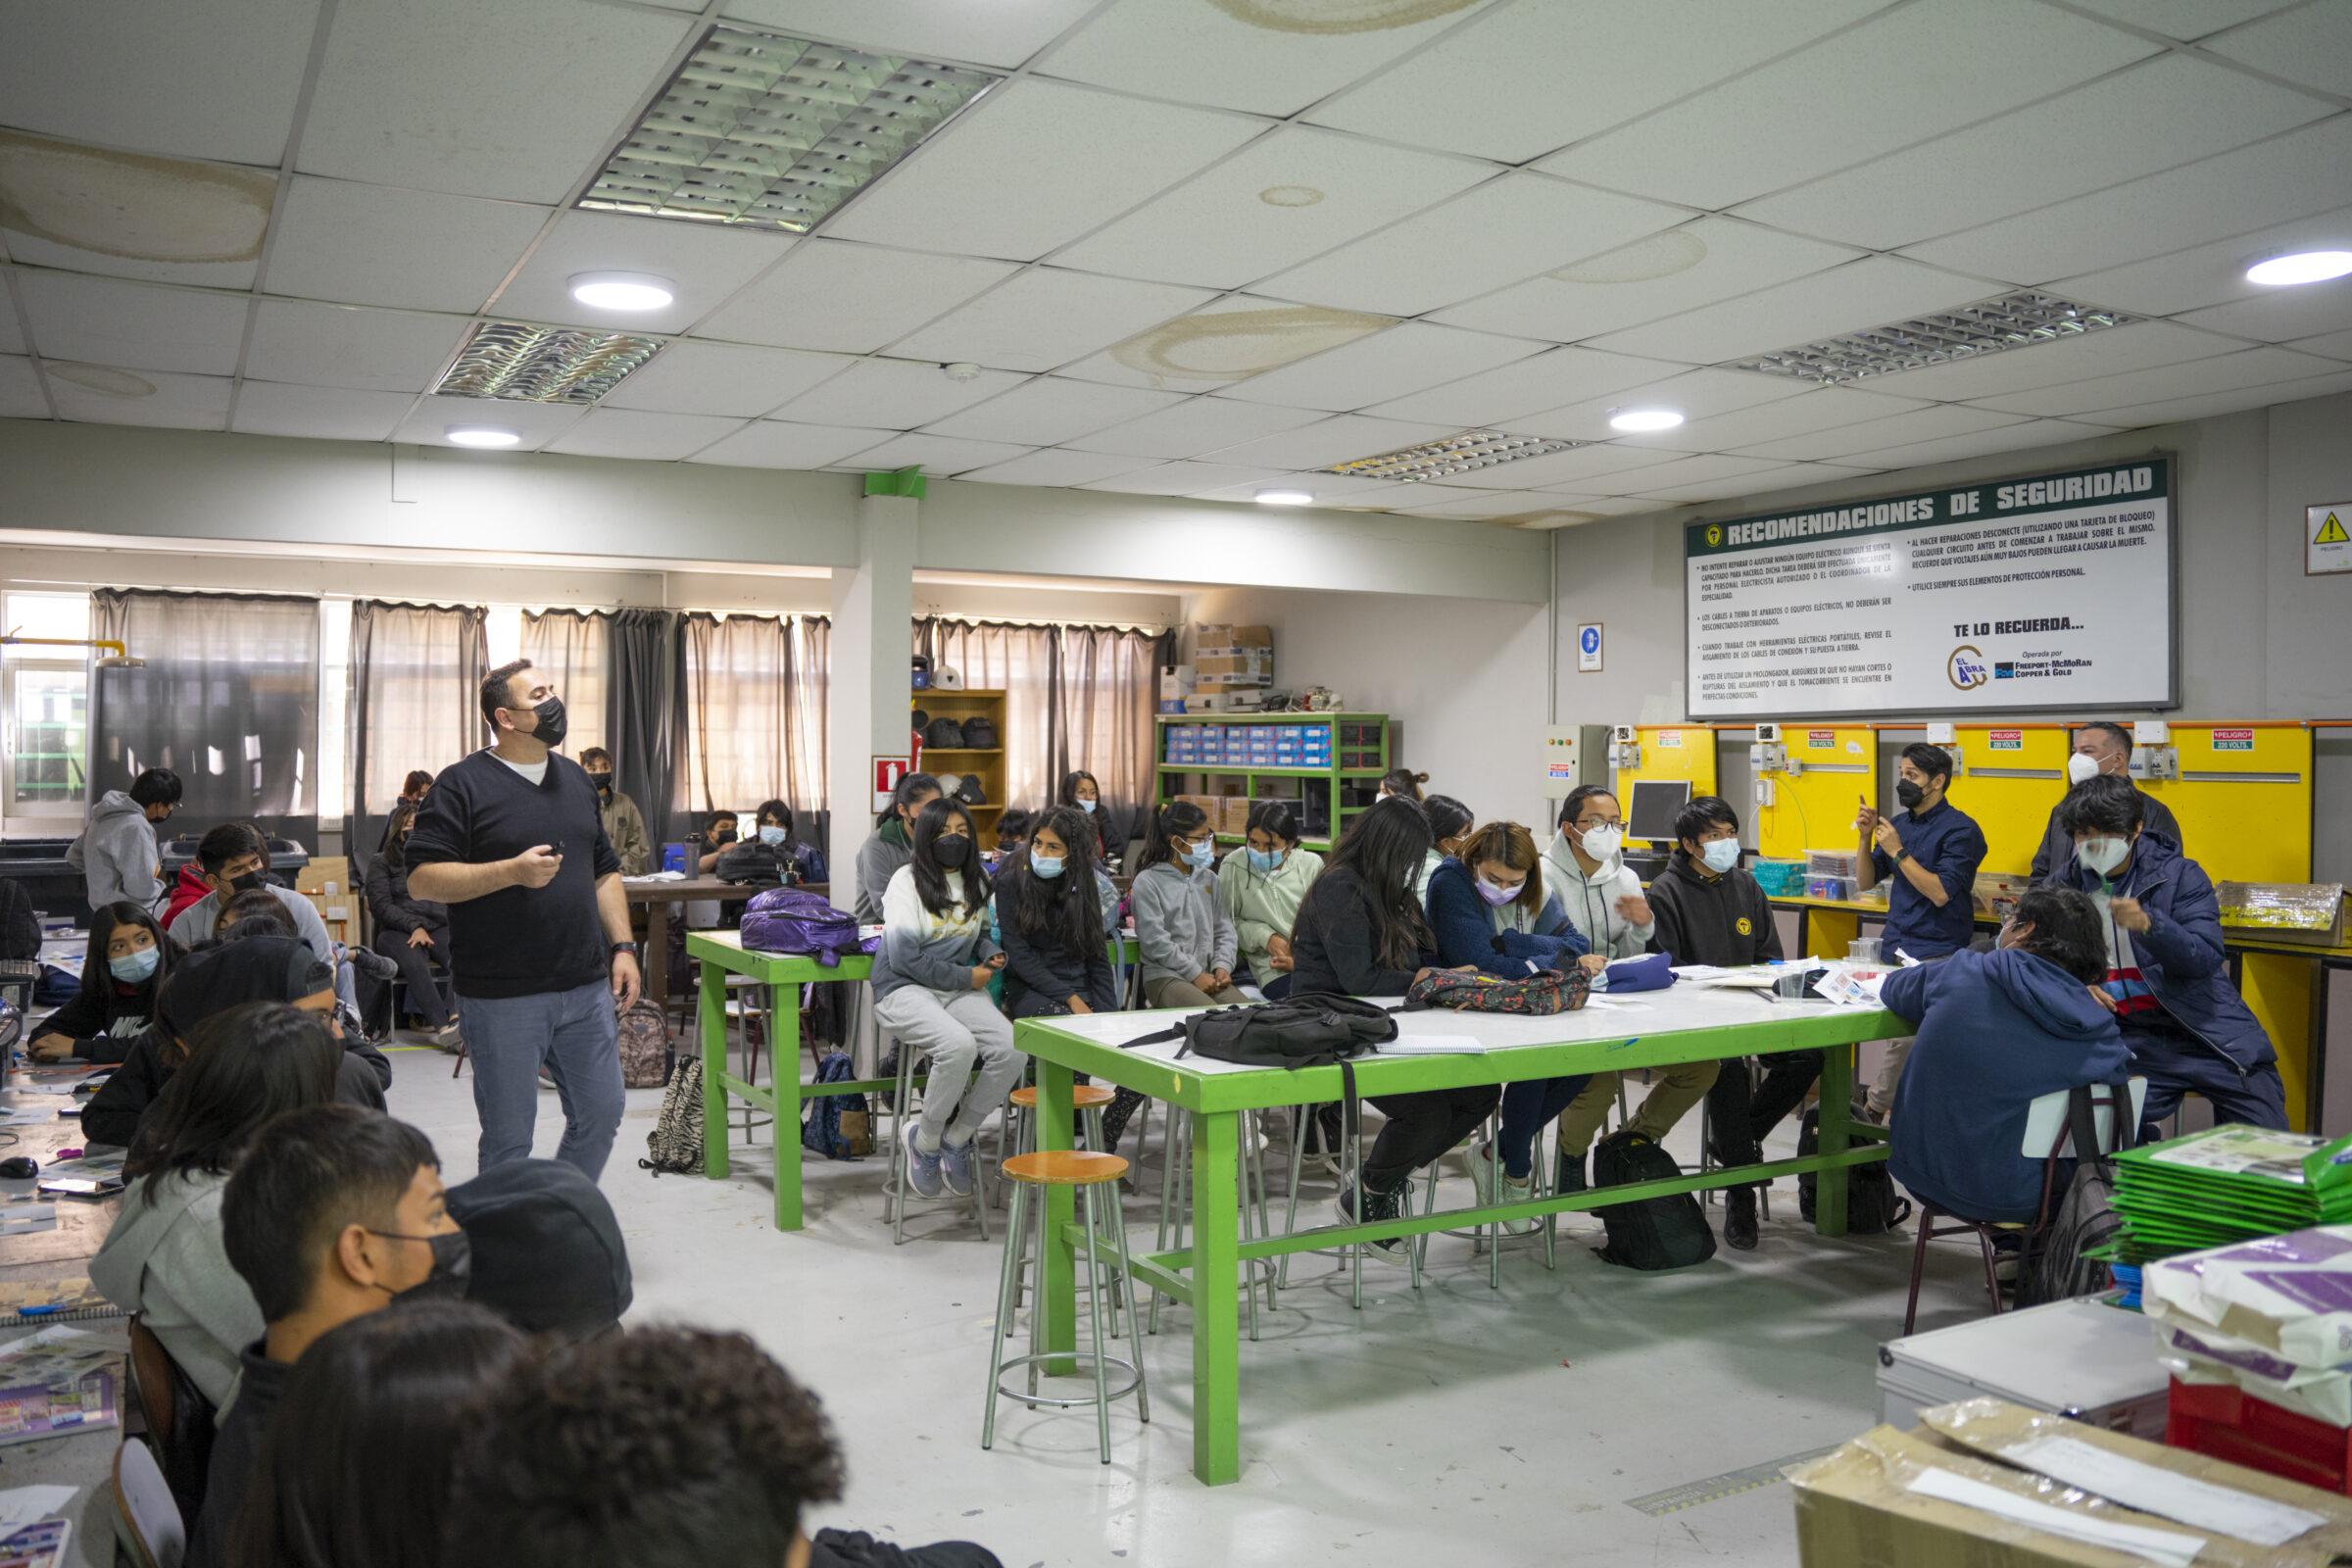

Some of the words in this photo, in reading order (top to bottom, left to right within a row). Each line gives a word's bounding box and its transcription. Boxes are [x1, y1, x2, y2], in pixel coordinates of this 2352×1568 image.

[1728, 498, 1934, 545] RECOMENDACIONES
[1950, 491, 1979, 516] DE
[1997, 467, 2152, 510] SEGURIDAD
[1920, 536, 1938, 545] HACER
[1940, 531, 1981, 543] REPARACIONES
[1983, 527, 2021, 538] DESCONECTE
[2022, 522, 2062, 534] (UTILIZANDO
[2064, 520, 2079, 529] UNA
[2081, 517, 2106, 527] TARJETA
[2108, 515, 2117, 524] DE
[2119, 511, 2155, 522] BLOQUEO)
[1912, 547, 1944, 558] CUALQUIER
[1946, 544, 1974, 554] CIRCUITO
[1977, 541, 1996, 551] ANTES
[1999, 540, 2007, 548] DE
[2010, 536, 2045, 547] COMENZAR
[2056, 531, 2088, 542] TRABAJAR
[2092, 529, 2114, 538] SOBRE
[2128, 524, 2155, 534] MISMO.
[1710, 562, 1728, 570] INTENTE
[1729, 559, 1748, 568] REPARAR
[1754, 557, 1774, 565] AJUSTAR
[1775, 553, 1795, 563] NINGÚN
[1796, 552, 1815, 560] EQUIPO
[1816, 548, 1841, 558] ELÉCTRICO
[1912, 559, 1940, 568] RECUERDE
[1940, 557, 1952, 565] QUE
[1953, 554, 1979, 564] VOLTAJES
[1980, 552, 1993, 561] AÚN
[1994, 551, 2008, 560] MUY
[2008, 549, 2027, 558] BAJOS
[2028, 547, 2053, 556] PUEDEN
[2053, 544, 2077, 553] LLEGAR
[2083, 541, 2108, 550] CAUSAR
[2117, 537, 2147, 546] MUERTE.
[1702, 572, 1729, 582] CAPACITADO
[1765, 566, 1781, 574] DICHA
[1798, 562, 1816, 571] DEBERÁ
[1828, 558, 1855, 567] EFECTUADA
[1912, 582, 1933, 591] UTILICE
[1933, 579, 1957, 589] SIEMPRE
[1958, 578, 1968, 587] SUS
[1969, 575, 2002, 586] ELEMENTOS
[2003, 574, 2011, 583] DE
[2012, 570, 2050, 582] PROTECCIÓN
[2051, 567, 2085, 578] PERSONAL.
[1714, 581, 1738, 590] PERSONAL
[1741, 578, 1774, 587] ELECTRICISTA
[1776, 574, 1810, 583] AUTORIZADO
[1759, 607, 1783, 616] APARATOS
[1790, 605, 1812, 613] EQUIPOS
[1856, 598, 1880, 607] DEBERÁN
[1702, 621, 1739, 631] DESCONECTADOS
[1954, 625, 1968, 637] TE
[1973, 623, 1990, 636] LO
[1995, 617, 2084, 634] RECUERDA...
[1702, 643, 1722, 651] CUANDO
[1759, 637, 1796, 647] HERRAMIENTAS
[1798, 635, 1827, 644] ELÉCTRICAS
[1702, 652, 1731, 661] AISLAMIENTO
[1777, 647, 1803, 655] CONEXIÓN
[1791, 667, 1818, 675] ASEGÚRESE
[1958, 665, 1986, 683] ABRA
[1739, 680, 1769, 688] AISLAMIENTO
[1798, 677, 1840, 685] TOMACORRIENTE
